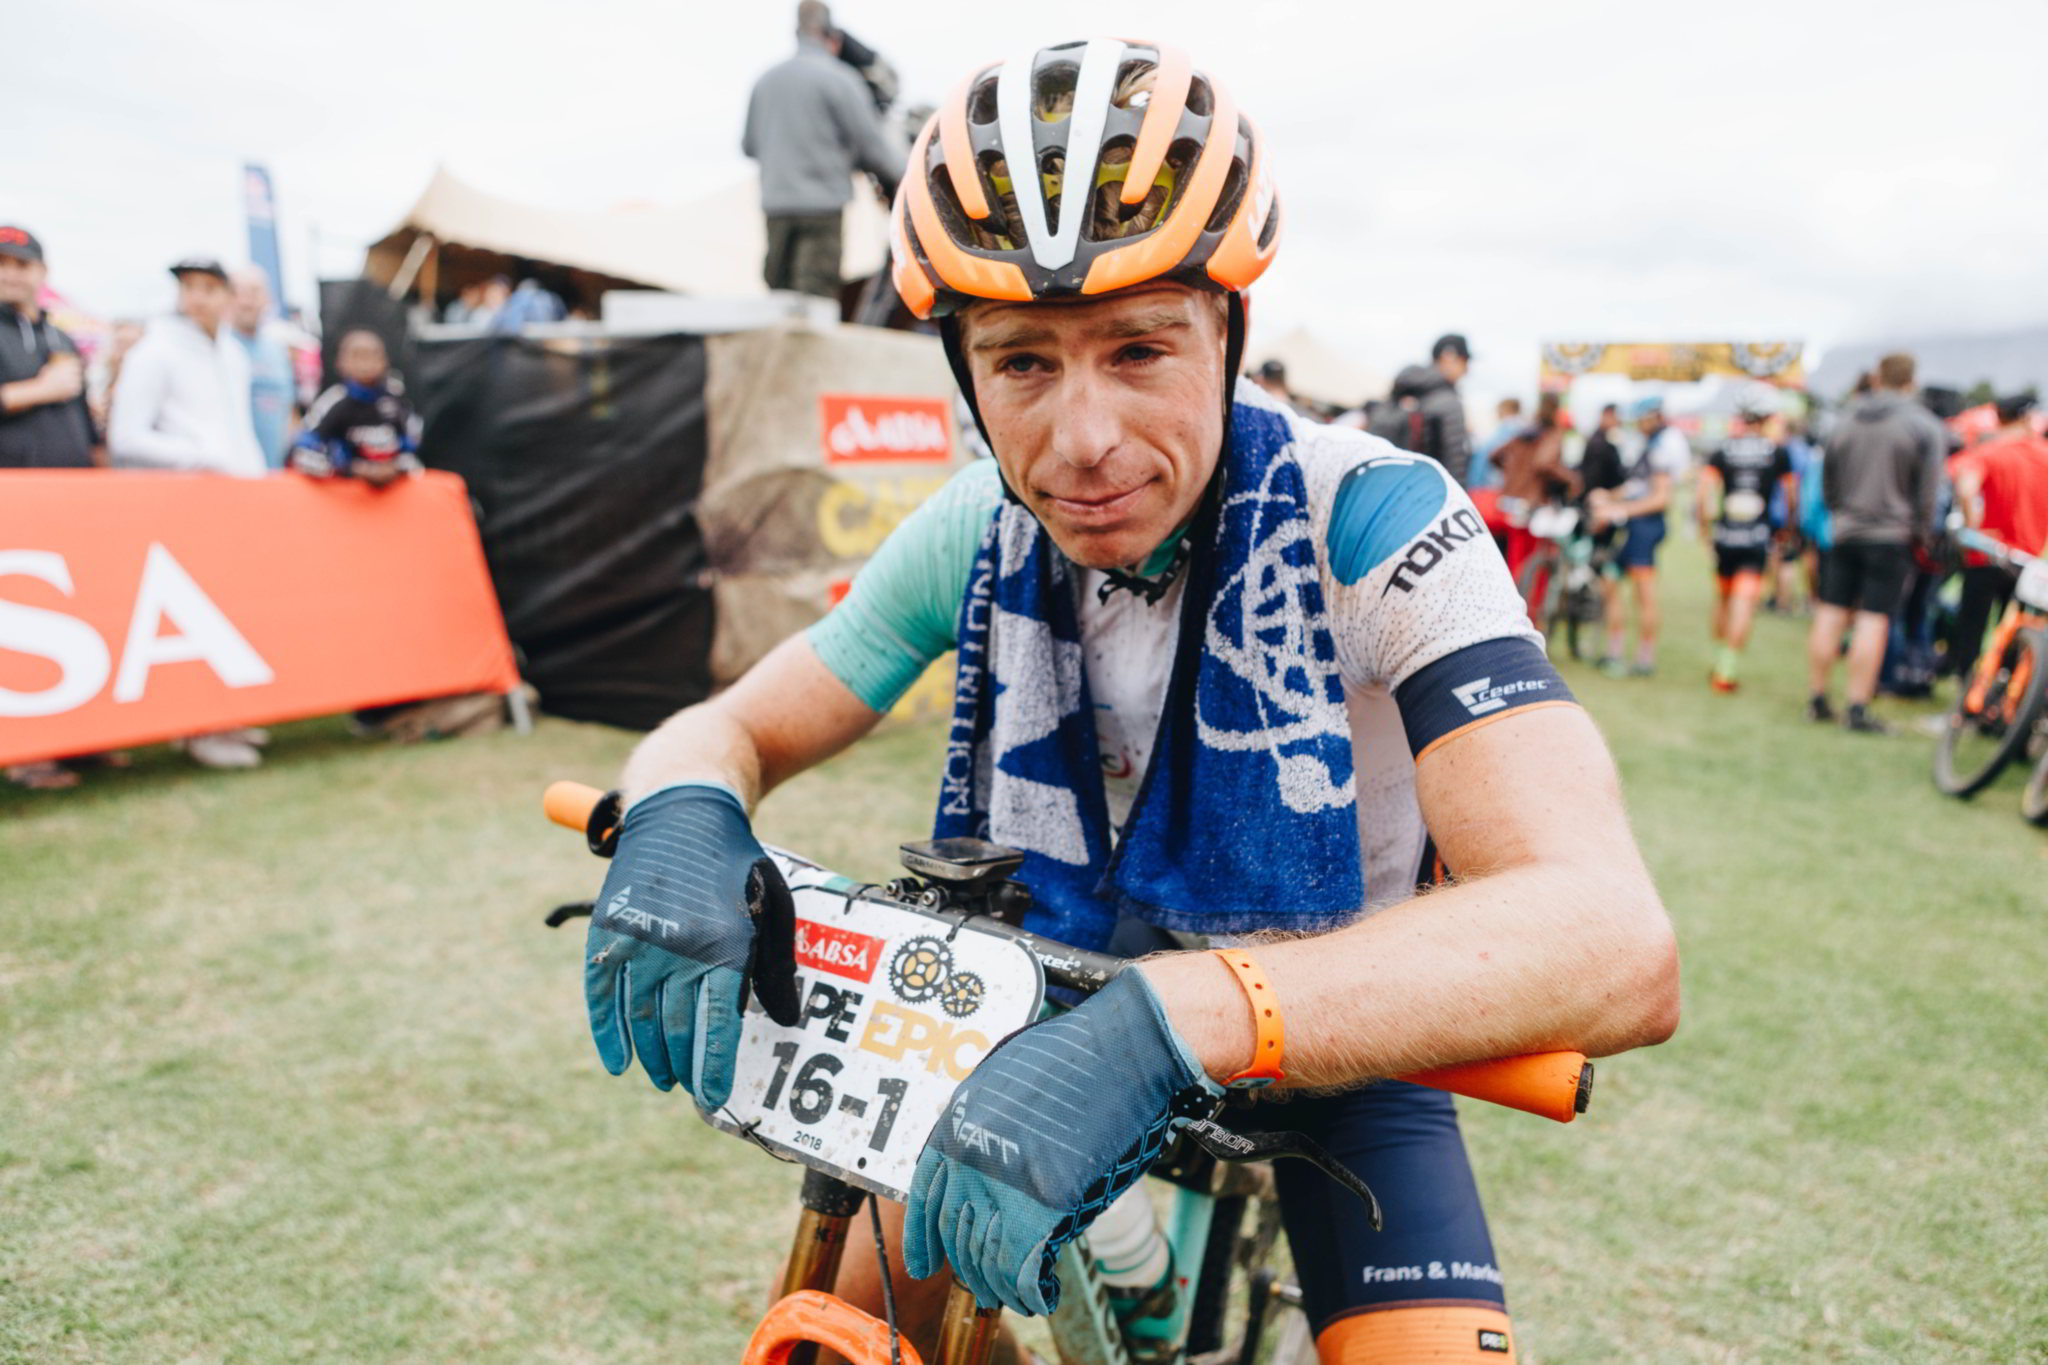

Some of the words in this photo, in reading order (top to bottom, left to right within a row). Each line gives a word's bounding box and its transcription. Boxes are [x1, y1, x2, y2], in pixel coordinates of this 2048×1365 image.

[811, 937, 869, 972] ABSA
[859, 999, 992, 1082] EPIC
[761, 1040, 909, 1153] 16-1
[792, 1130, 823, 1151] 2018
[1362, 1264, 1424, 1284] Frans
[1427, 1260, 1449, 1280] &
